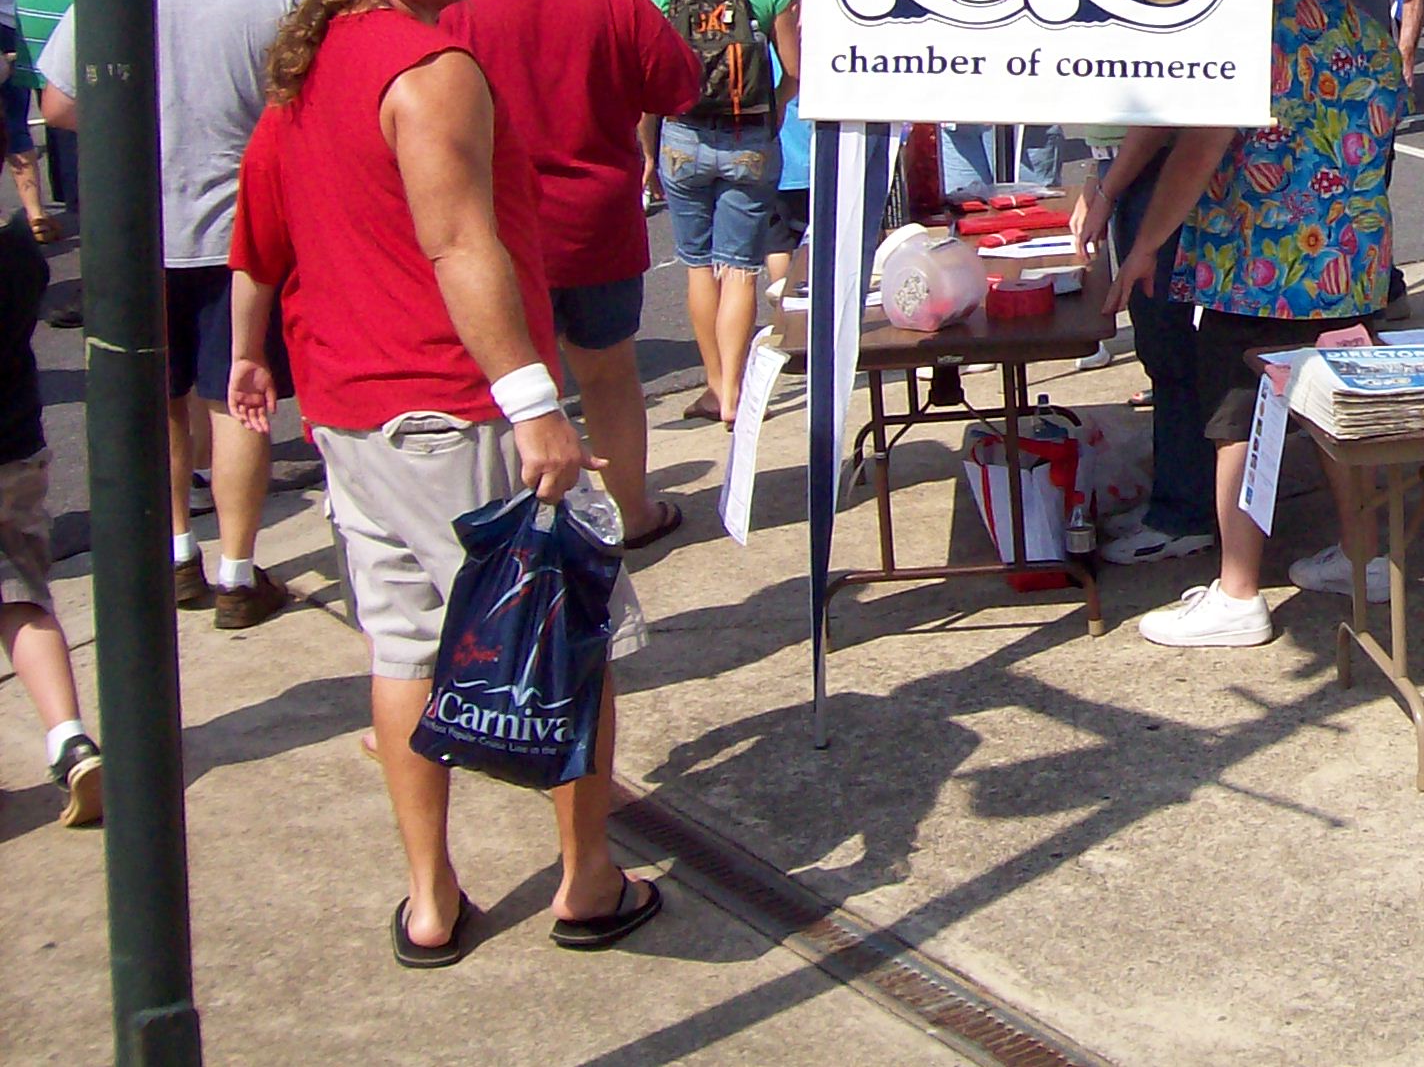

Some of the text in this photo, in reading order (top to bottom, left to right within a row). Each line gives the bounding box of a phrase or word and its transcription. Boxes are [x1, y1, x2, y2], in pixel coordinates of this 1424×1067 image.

[831, 46, 1238, 81] chamber of commerce
[437, 691, 572, 743] Carniva
